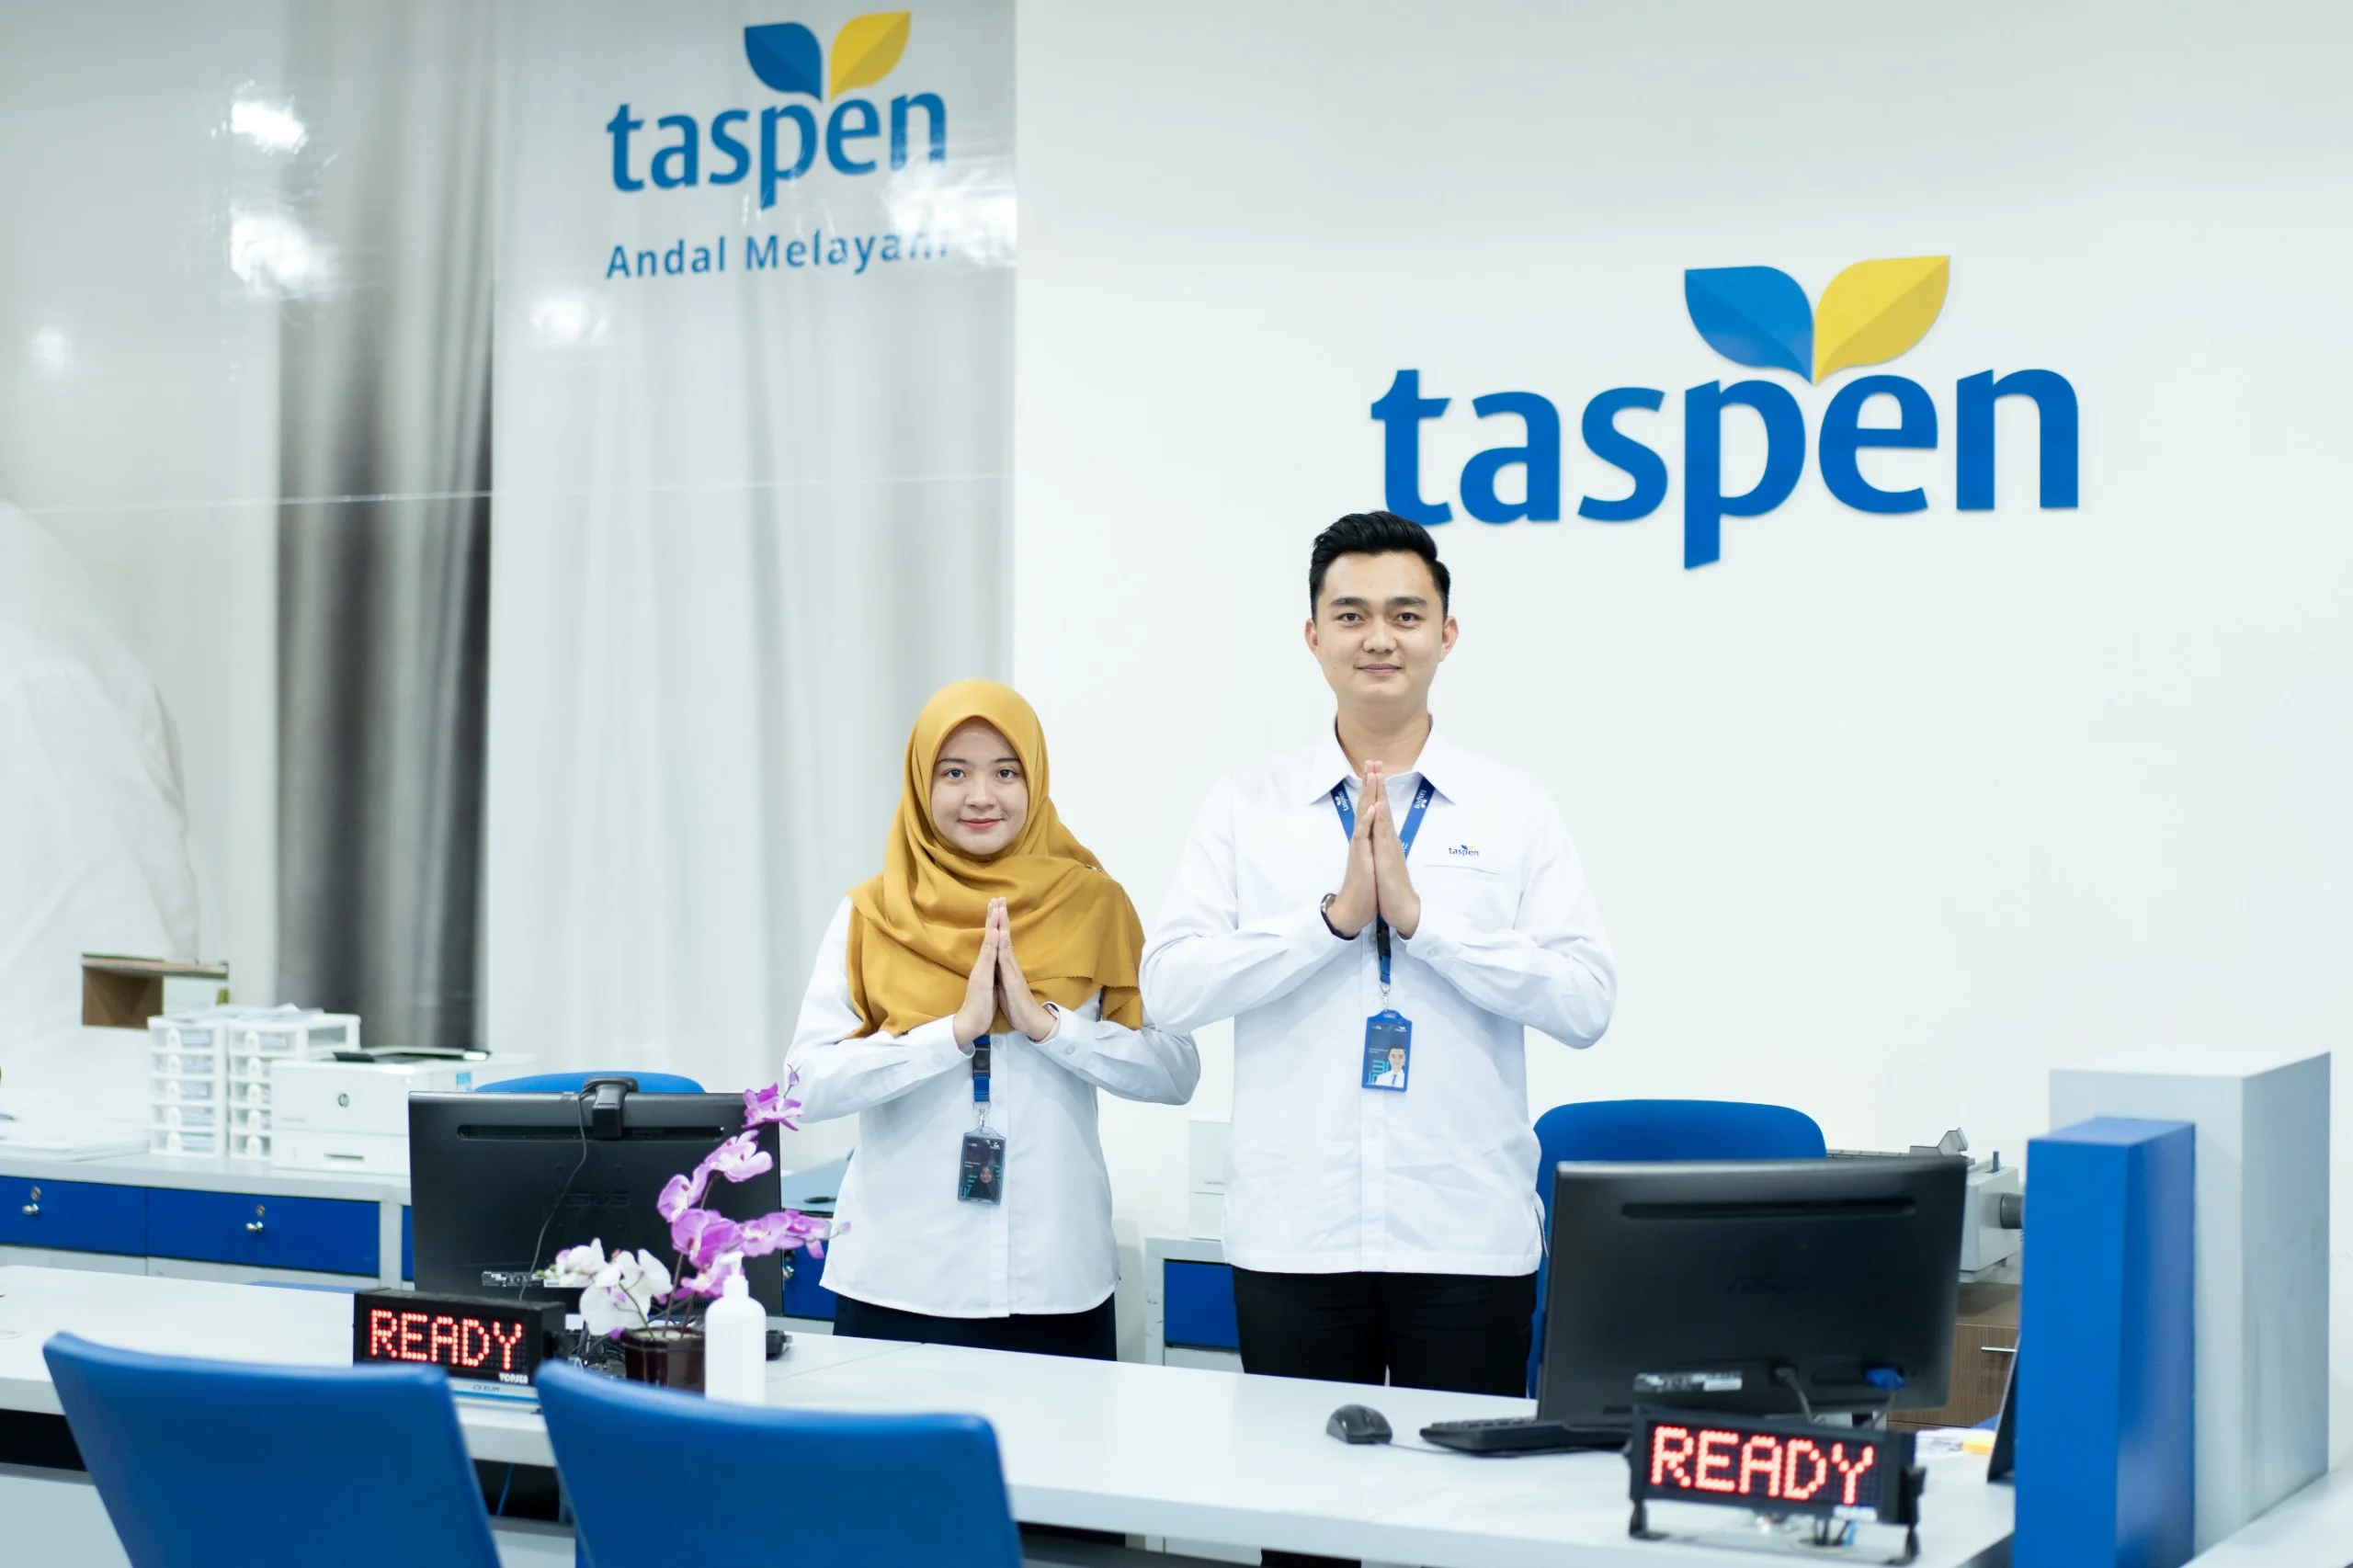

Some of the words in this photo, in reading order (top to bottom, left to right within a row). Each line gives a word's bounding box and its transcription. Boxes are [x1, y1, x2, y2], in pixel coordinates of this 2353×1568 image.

[606, 92, 947, 210] taspen
[606, 236, 726, 279] Andal
[1370, 369, 2079, 571] taspen
[1449, 847, 1479, 857] taspen
[370, 1309, 522, 1370] READY
[1650, 1426, 1875, 1505] READY
